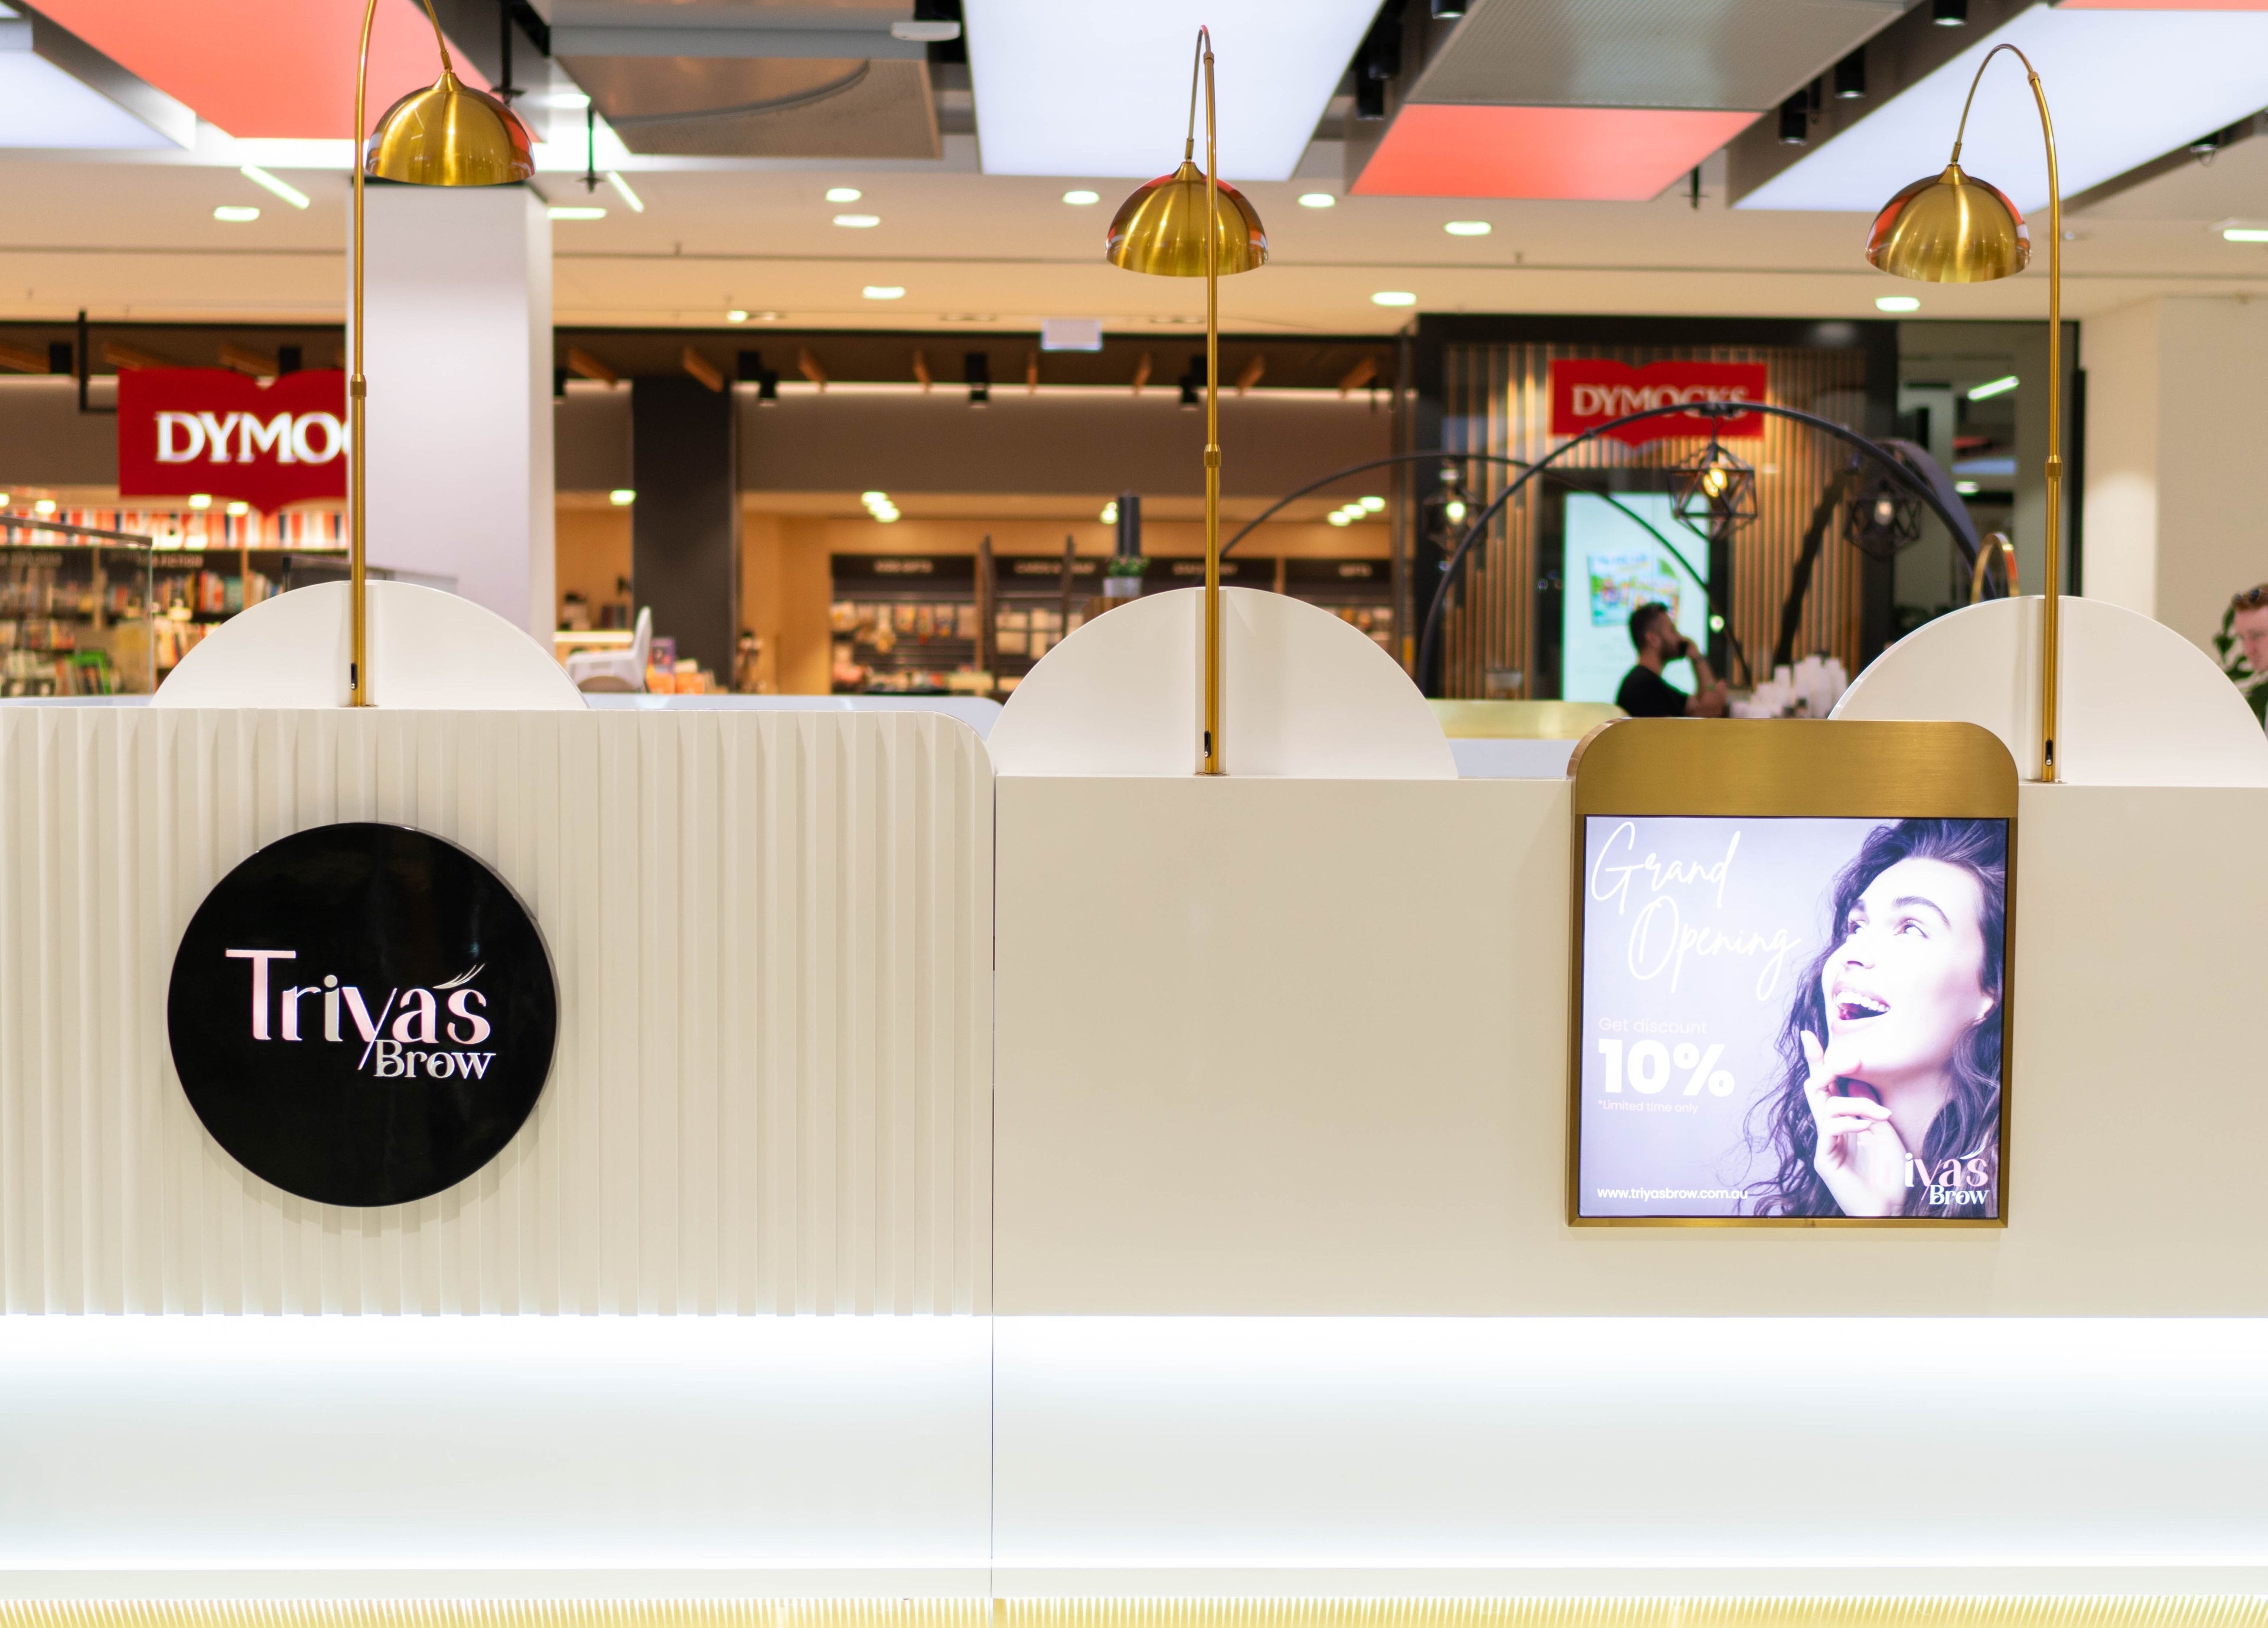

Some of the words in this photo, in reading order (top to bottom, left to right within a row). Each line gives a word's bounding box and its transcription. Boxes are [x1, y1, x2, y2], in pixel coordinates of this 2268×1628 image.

[154, 411, 352, 465] DYMO
[1591, 821, 1741, 916] Grand
[1628, 895, 1801, 1001] Opening
[1598, 1017, 1629, 1031] Get
[1633, 1018, 1707, 1034] discount
[373, 1039, 497, 1079] Brow
[1598, 1038, 1735, 1097] 10%
[1646, 1101, 1673, 1112] time
[1674, 1102, 1699, 1115] only
[1596, 1187, 1748, 1202] www.triyasbrow.com.au
[1928, 1184, 1990, 1205] Brow
